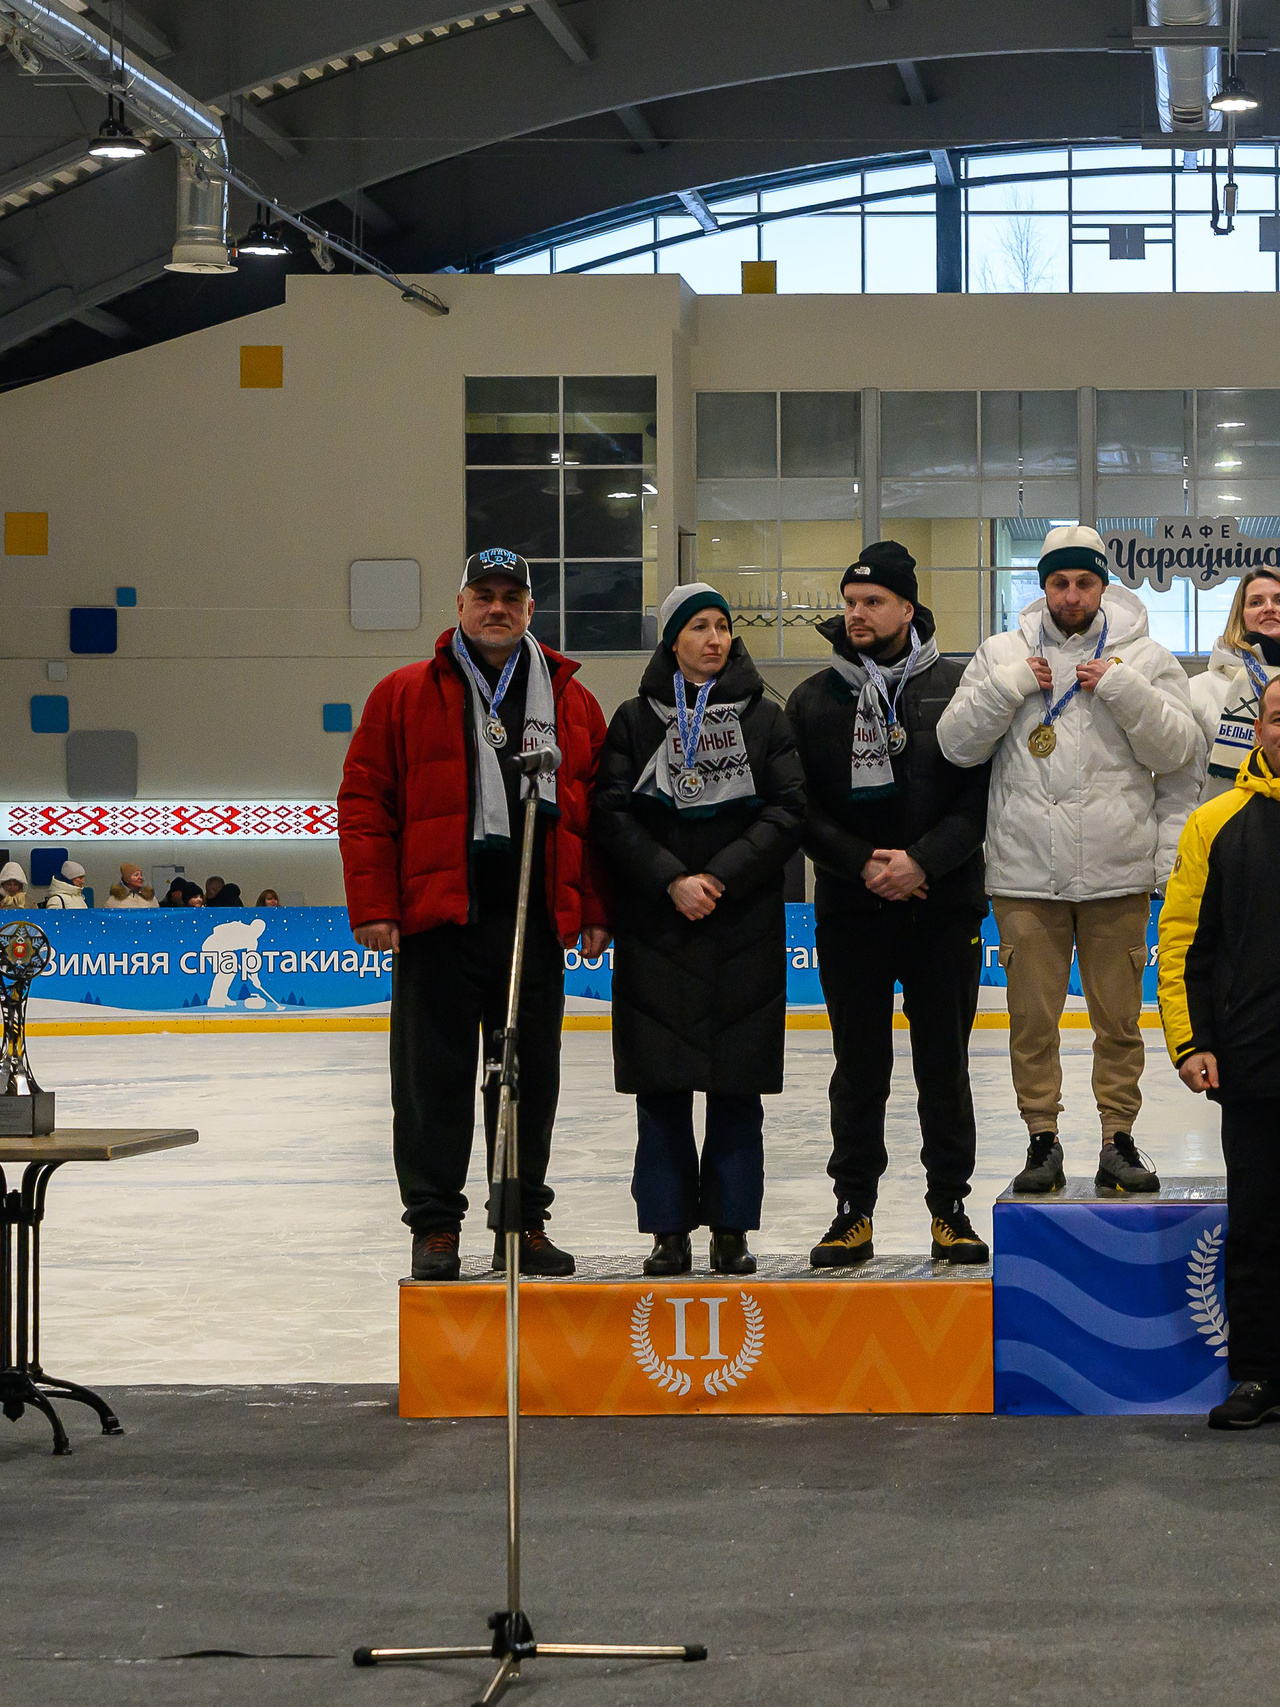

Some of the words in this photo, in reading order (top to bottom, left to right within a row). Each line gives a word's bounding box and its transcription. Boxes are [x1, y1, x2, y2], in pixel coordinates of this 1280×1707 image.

[1164, 524, 1230, 539] КАФЕ
[673, 730, 738, 754] ЕИНЫЕ
[1219, 723, 1255, 741] БЕЛЫЕ
[665, 1297, 729, 1360] II
